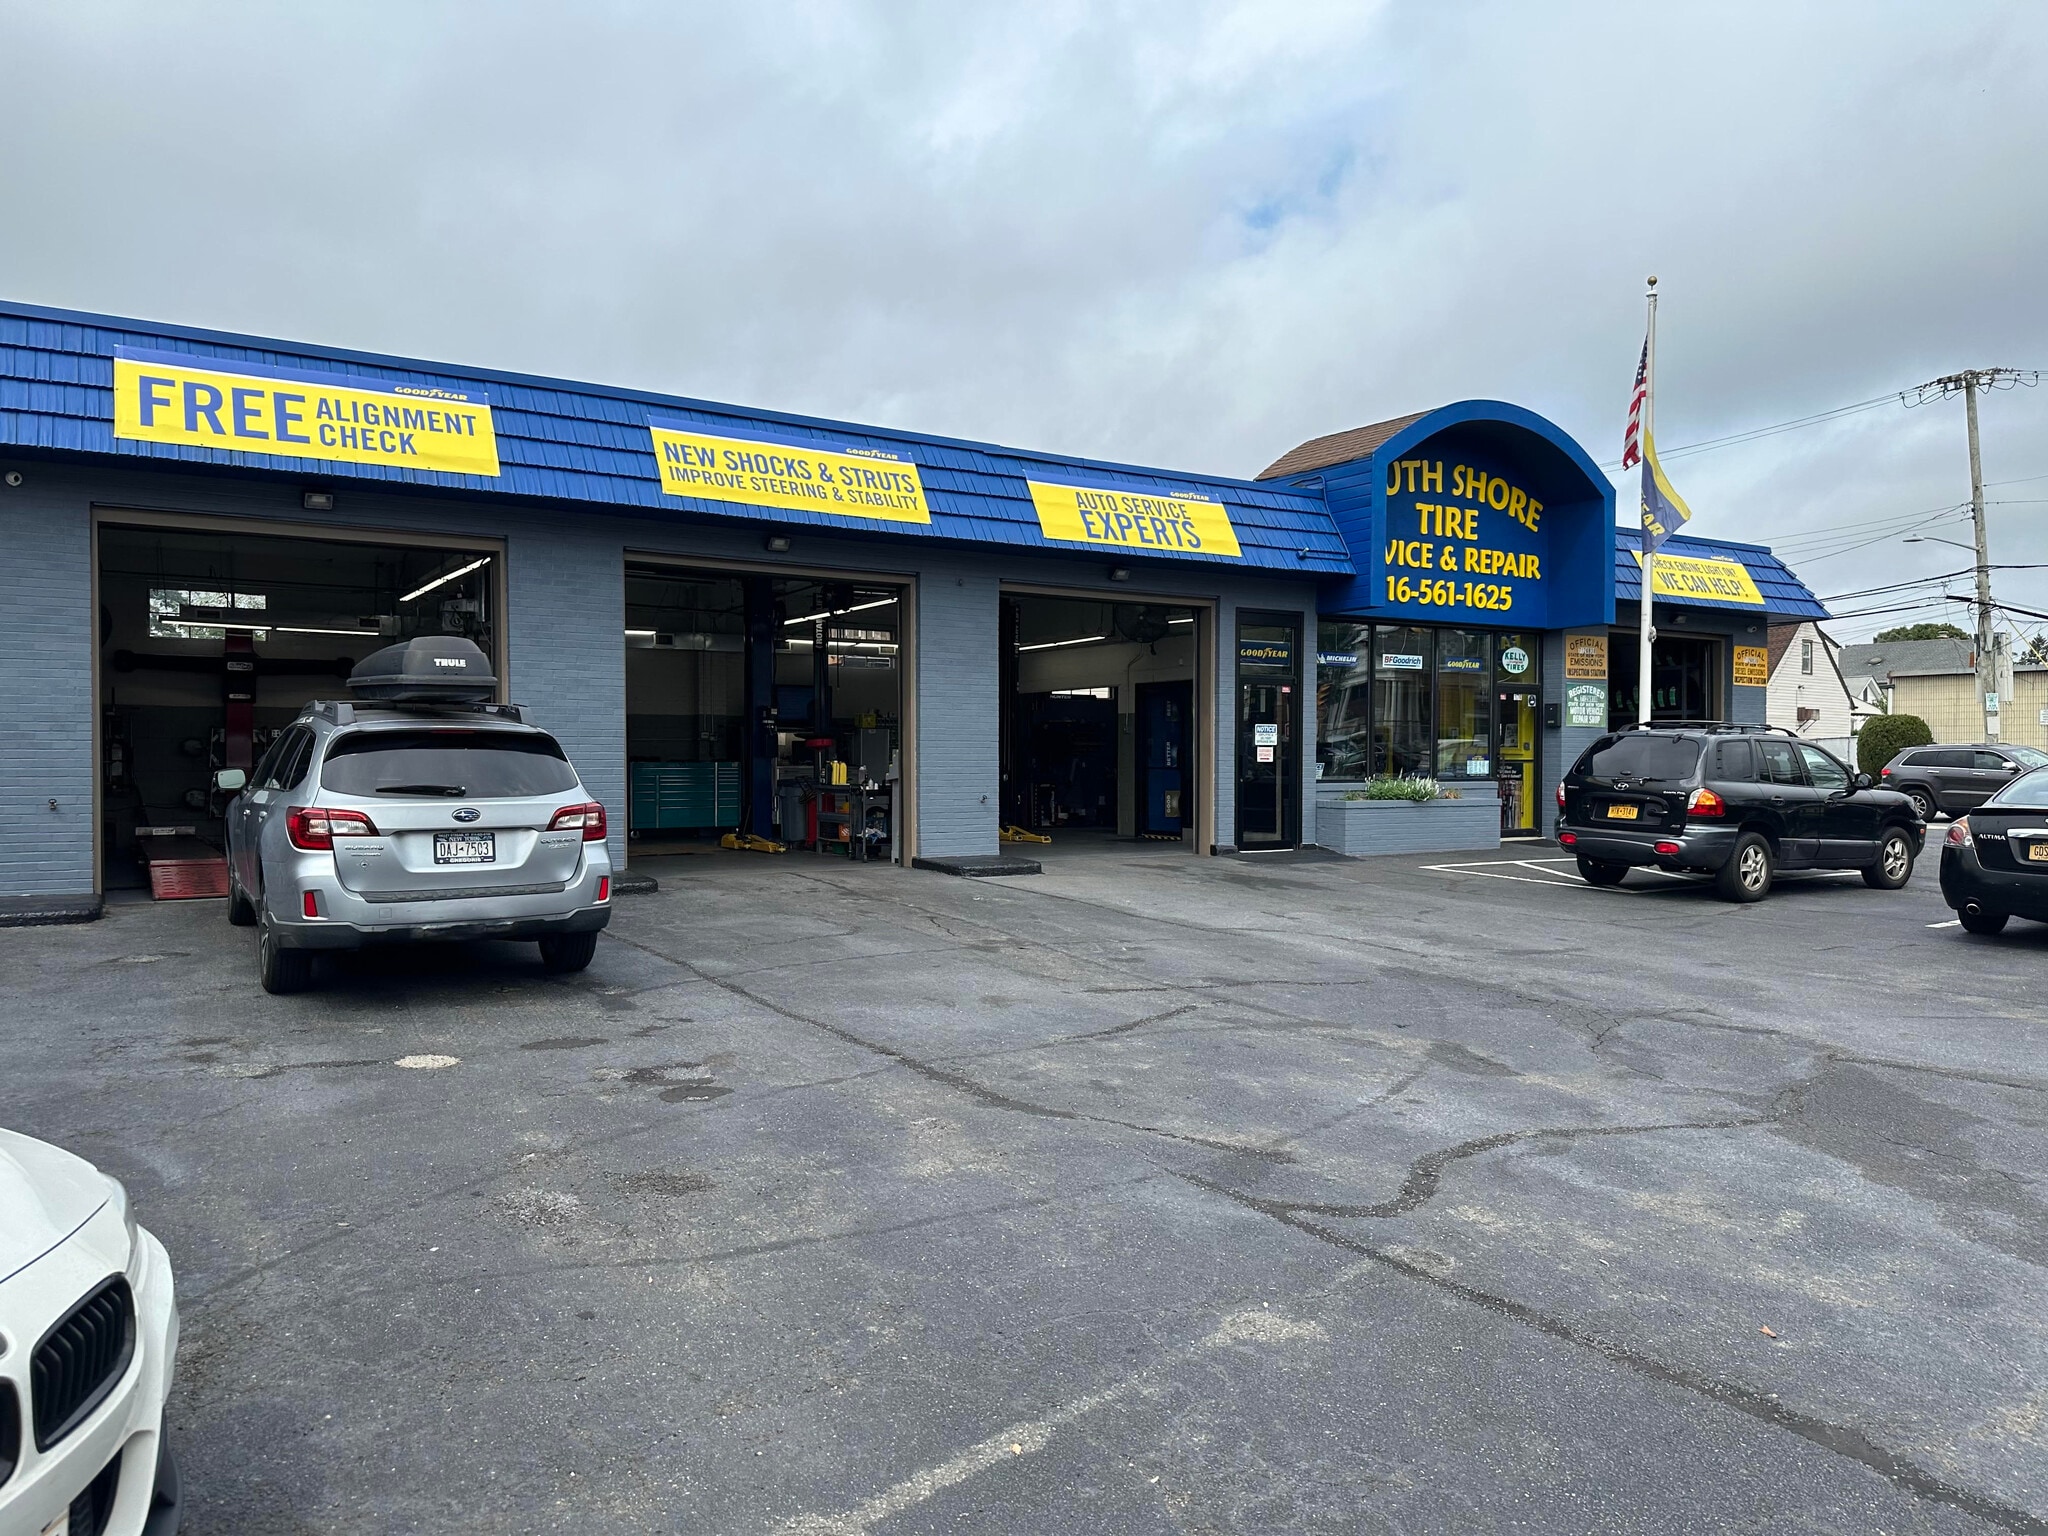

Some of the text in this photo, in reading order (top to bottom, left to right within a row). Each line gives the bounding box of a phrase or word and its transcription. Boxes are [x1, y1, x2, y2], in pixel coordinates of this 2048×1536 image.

[394, 386, 469, 401] GOODYEAR
[139, 375, 476, 444] FREE ALIGNMENT
[319, 423, 418, 455] CHECK
[846, 447, 899, 461] GOODYEAR
[663, 441, 916, 493] NEW SHOCKS & STRUTS
[668, 466, 919, 511] IMPROVE STEERING & STABILITY
[1170, 491, 1210, 501] GOODYEAR
[1452, 464, 1544, 533] SHORE
[1075, 491, 1192, 520] AUTO SERVICE
[1415, 502, 1479, 540] TIRE
[1079, 510, 1202, 548] EXPERTS
[1385, 540, 1541, 580] VICE & REPAIR
[1674, 561, 1703, 573] ENGINE
[1700, 564, 1724, 576] LIGHT
[1656, 571, 1749, 598] WE CAN HELP!
[1386, 576, 1513, 611] 16-561-1625
[1570, 638, 1604, 651] OFFICIAL
[1240, 647, 1288, 659] GOODYEAR
[1326, 655, 1357, 663] MICHELIN
[1504, 652, 1526, 661] KELLY
[1736, 649, 1765, 661] OFFICIAL
[434, 658, 467, 668] THULE
[1384, 656, 1421, 665] BFGoodrich
[1447, 659, 1480, 669] GOODYEAR
[1506, 663, 1525, 671] TIRES
[1570, 658, 1604, 667] EMISSIONS
[1568, 685, 1605, 699] REGISTERED
[1572, 715, 1601, 724] REPAIR SHOP
[1979, 833, 2006, 841] ALTIMA
